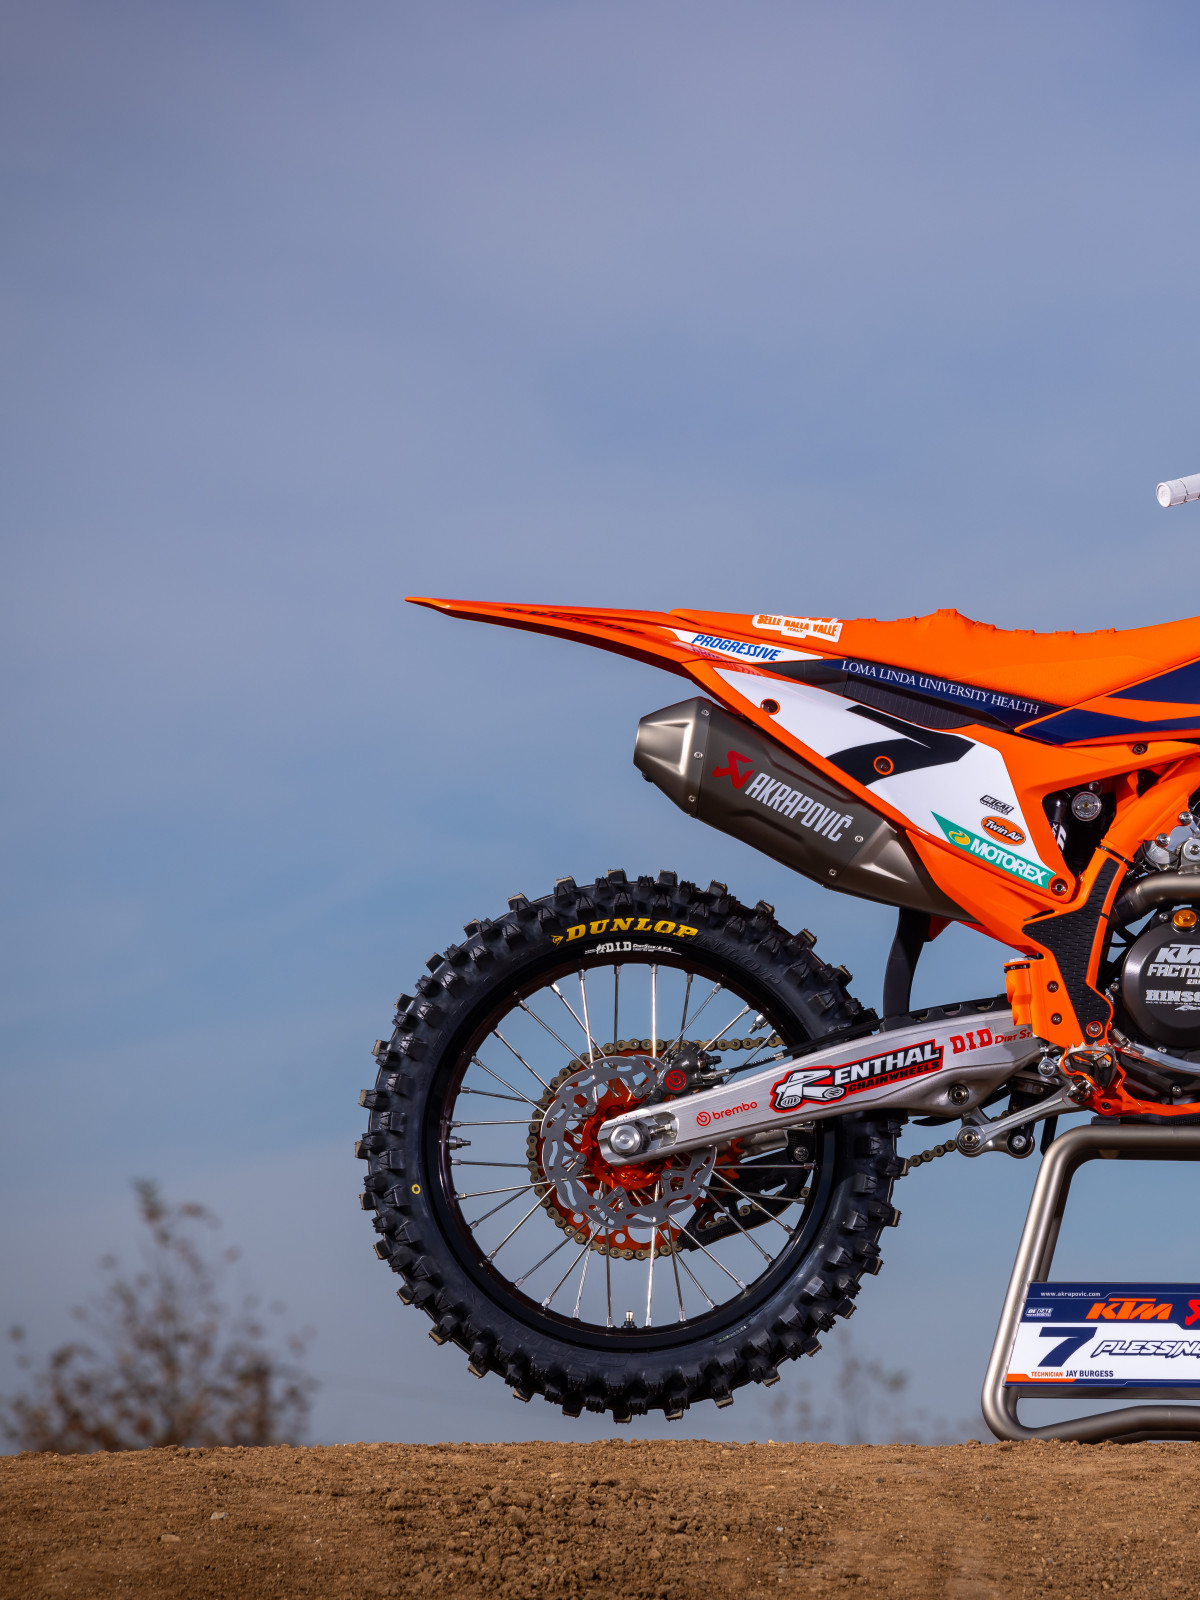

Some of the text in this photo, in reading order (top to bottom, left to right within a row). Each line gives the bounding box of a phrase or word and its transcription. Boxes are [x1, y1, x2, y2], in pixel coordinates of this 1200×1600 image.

[757, 614, 838, 637] SELLE DALLA VALLE
[691, 634, 782, 661] PROGRESSIVE
[841, 660, 1040, 715] LOMA LINDA UNIVERSITY HEALTH
[984, 818, 1025, 842] Twin Air
[969, 838, 1047, 885] MOTOREX
[566, 917, 699, 942] DUNLOP
[949, 1028, 993, 1055] D.I.D
[1018, 1028, 1034, 1039] ST
[849, 1060, 940, 1092] CHAINWHEELS
[711, 1100, 759, 1121] brembo
[1040, 1290, 1101, 1298] www.akrapovic.com
[1085, 1297, 1173, 1320] KTM
[1037, 1326, 1098, 1368] 7
[1065, 1370, 1078, 1378] JAY
[1079, 1370, 1114, 1378] BURGESS
